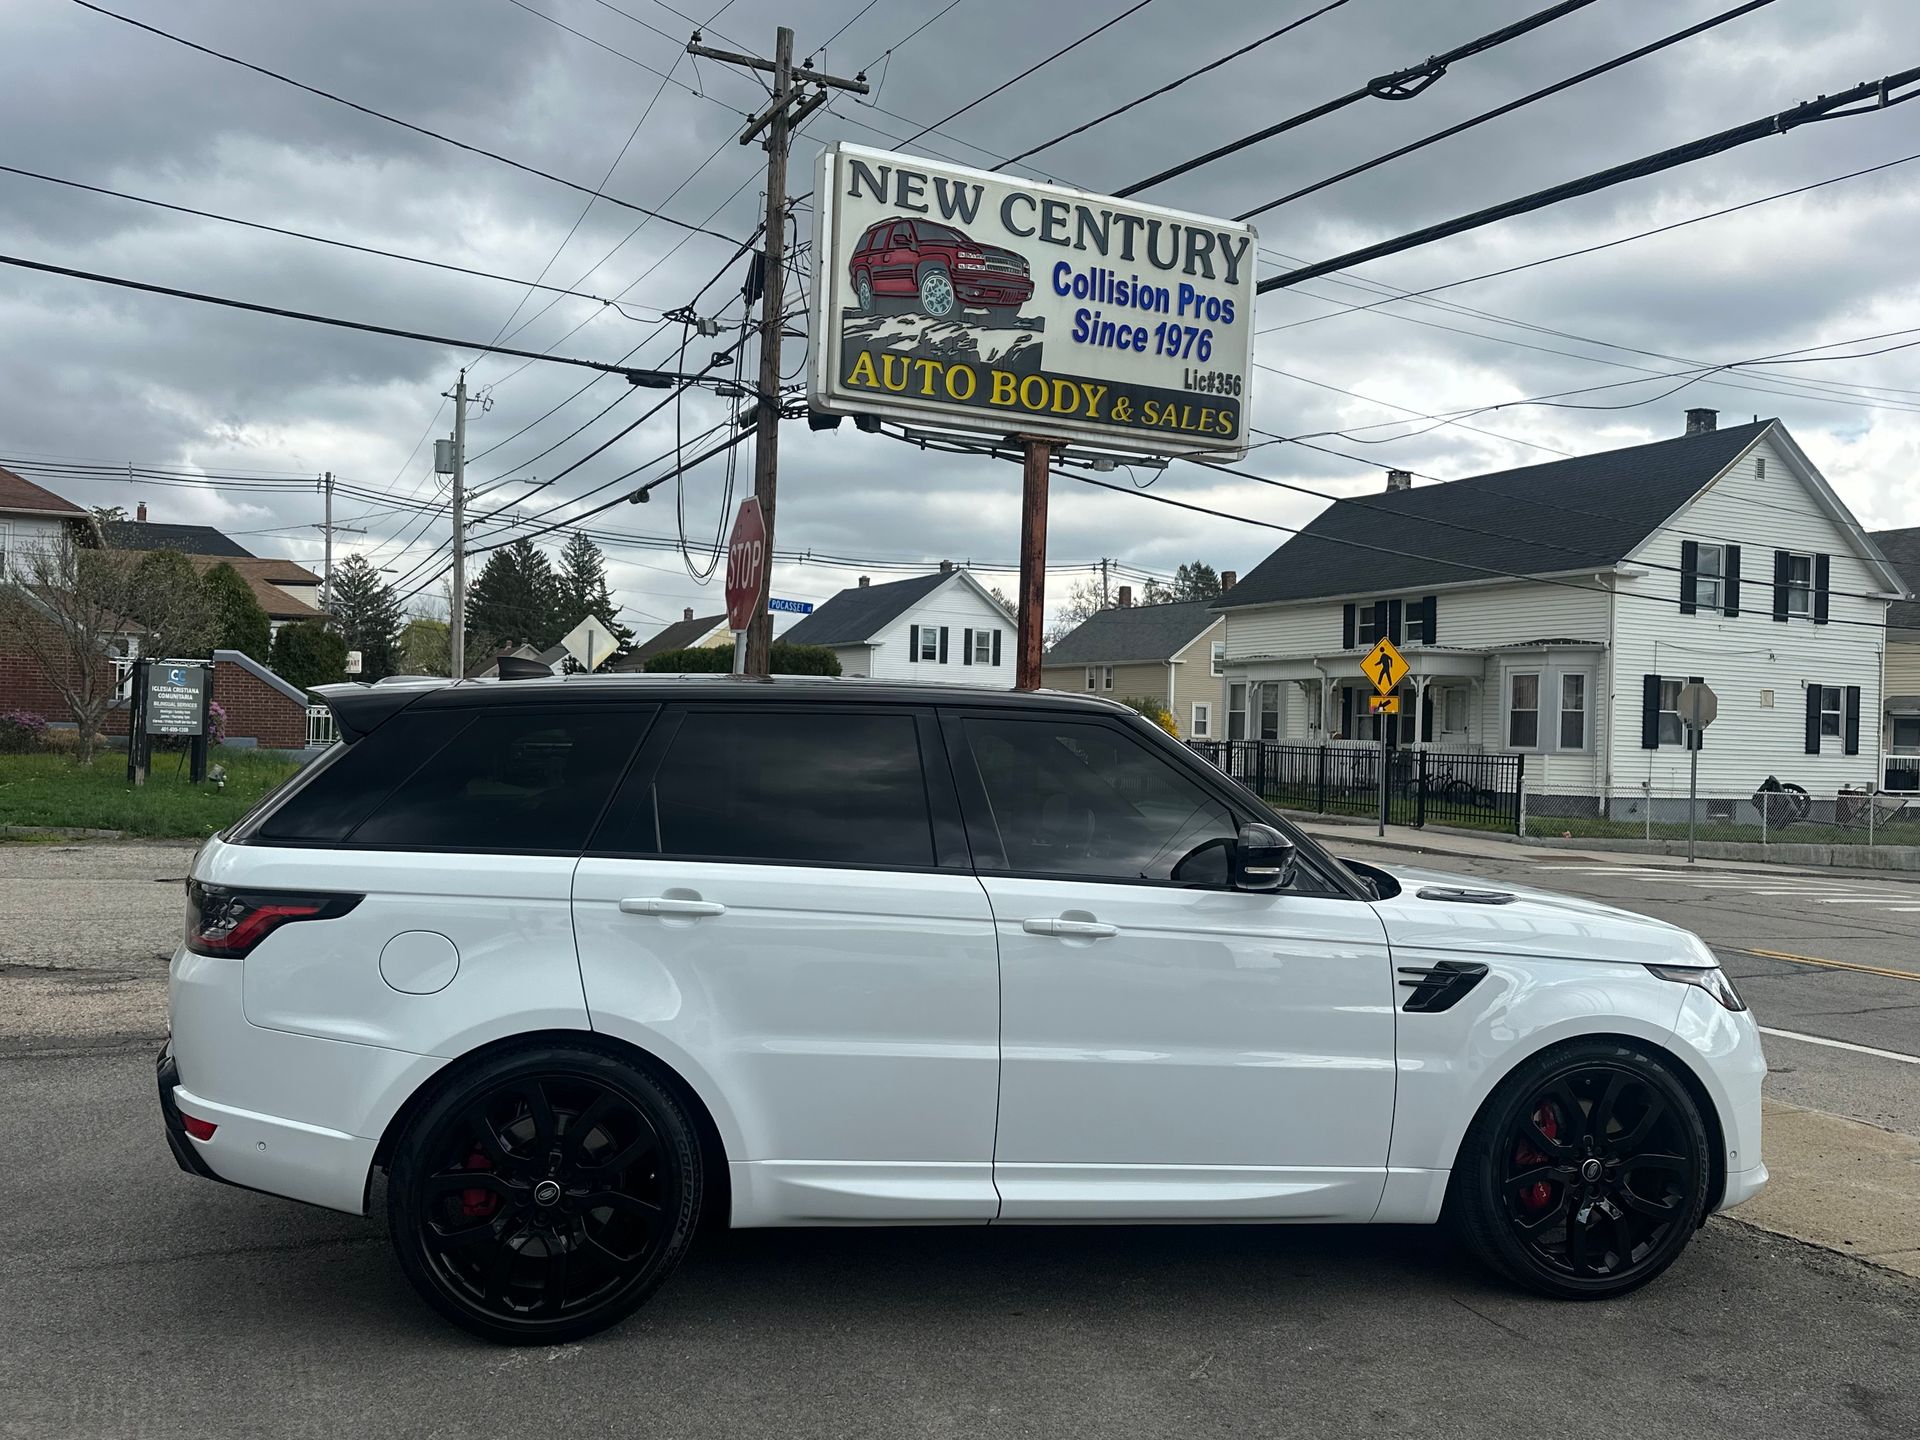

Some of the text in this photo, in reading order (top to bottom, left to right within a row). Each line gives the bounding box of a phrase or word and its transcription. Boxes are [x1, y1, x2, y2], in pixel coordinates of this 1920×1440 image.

[848, 159, 1251, 285] NEW CENTURY
[1052, 261, 1235, 325] Collision Pros
[1072, 308, 1213, 362] Since 1976
[847, 350, 1235, 436] AUTO BODY & SALES
[1183, 367, 1242, 397] Lic#356
[728, 540, 761, 591] STOP
[771, 599, 805, 612] POCASSET
